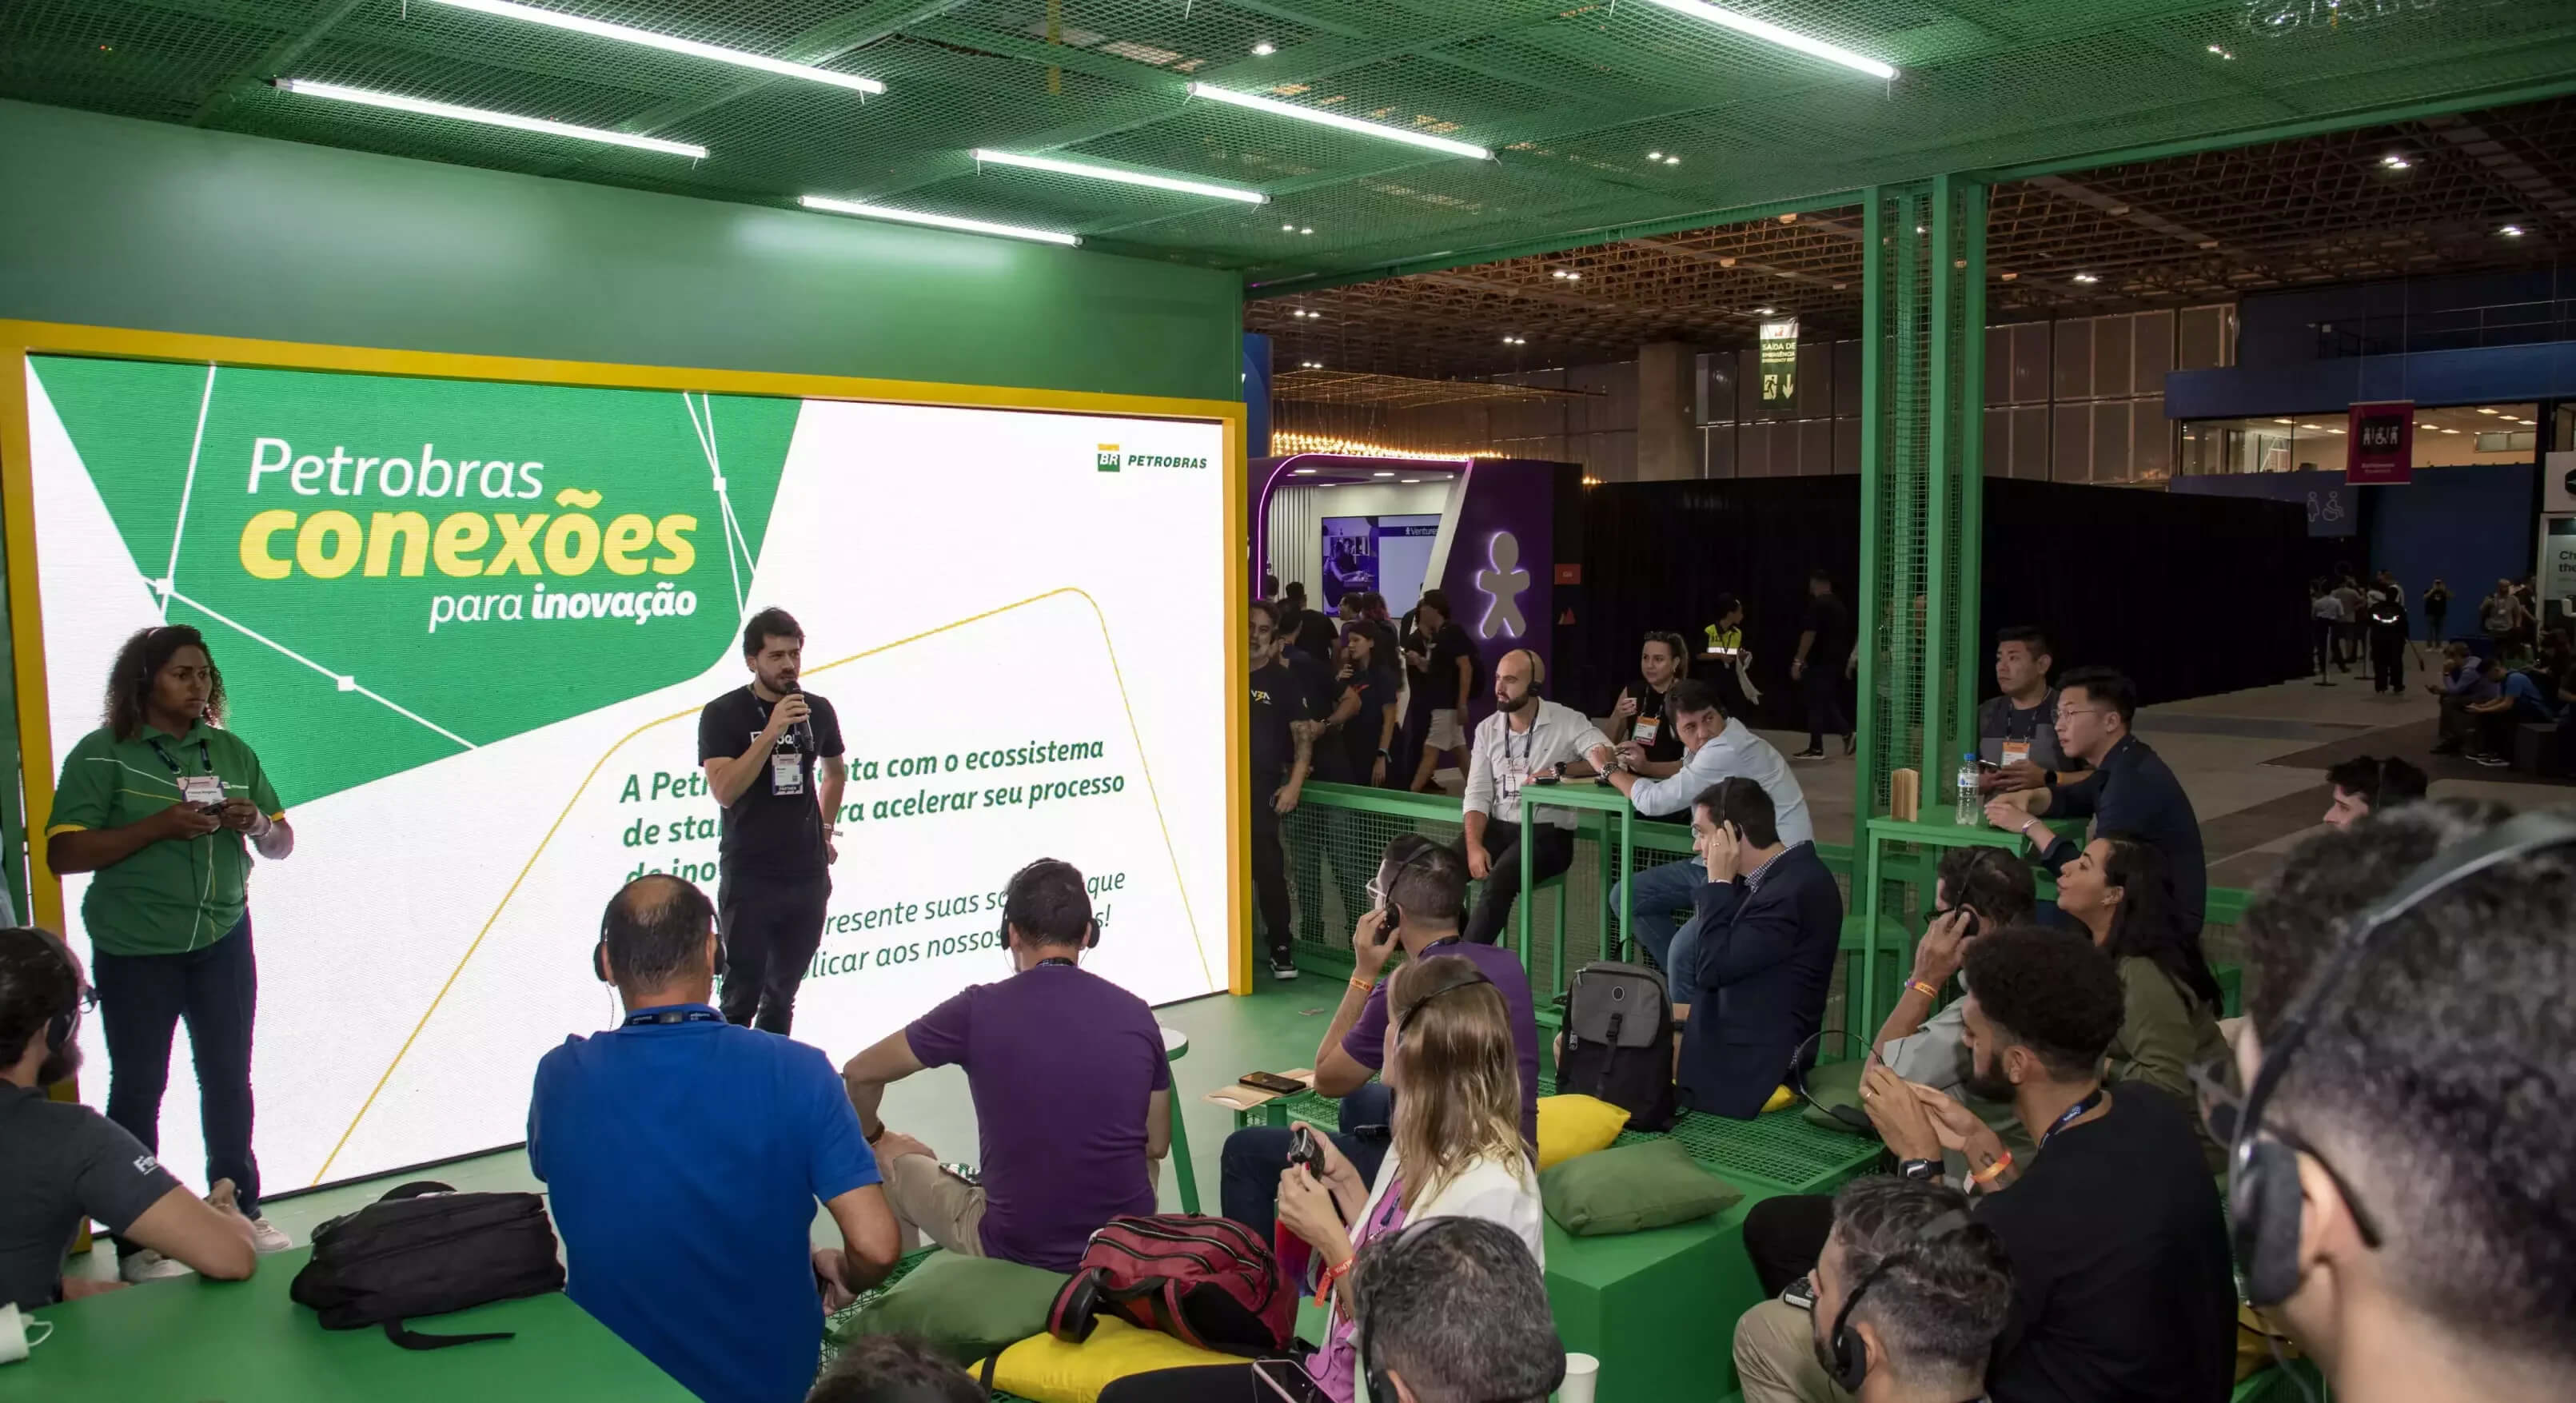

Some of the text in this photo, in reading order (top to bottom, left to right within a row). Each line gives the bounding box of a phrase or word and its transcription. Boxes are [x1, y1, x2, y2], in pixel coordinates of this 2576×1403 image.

[247, 436, 545, 499] Petrobras
[1127, 454, 1208, 469] PETROBRAS
[239, 488, 698, 580] conexões
[428, 582, 698, 633] para inovação
[619, 774, 641, 803] A
[652, 771, 708, 800] Petr
[887, 755, 937, 779] com
[944, 754, 959, 772] o
[965, 740, 1104, 771] ecossistema
[623, 775, 1125, 847] de sta ra acelerar seu processo
[825, 901, 919, 935] resente
[924, 893, 979, 920] suas
[1087, 872, 1126, 900] que
[875, 942, 919, 967] aos
